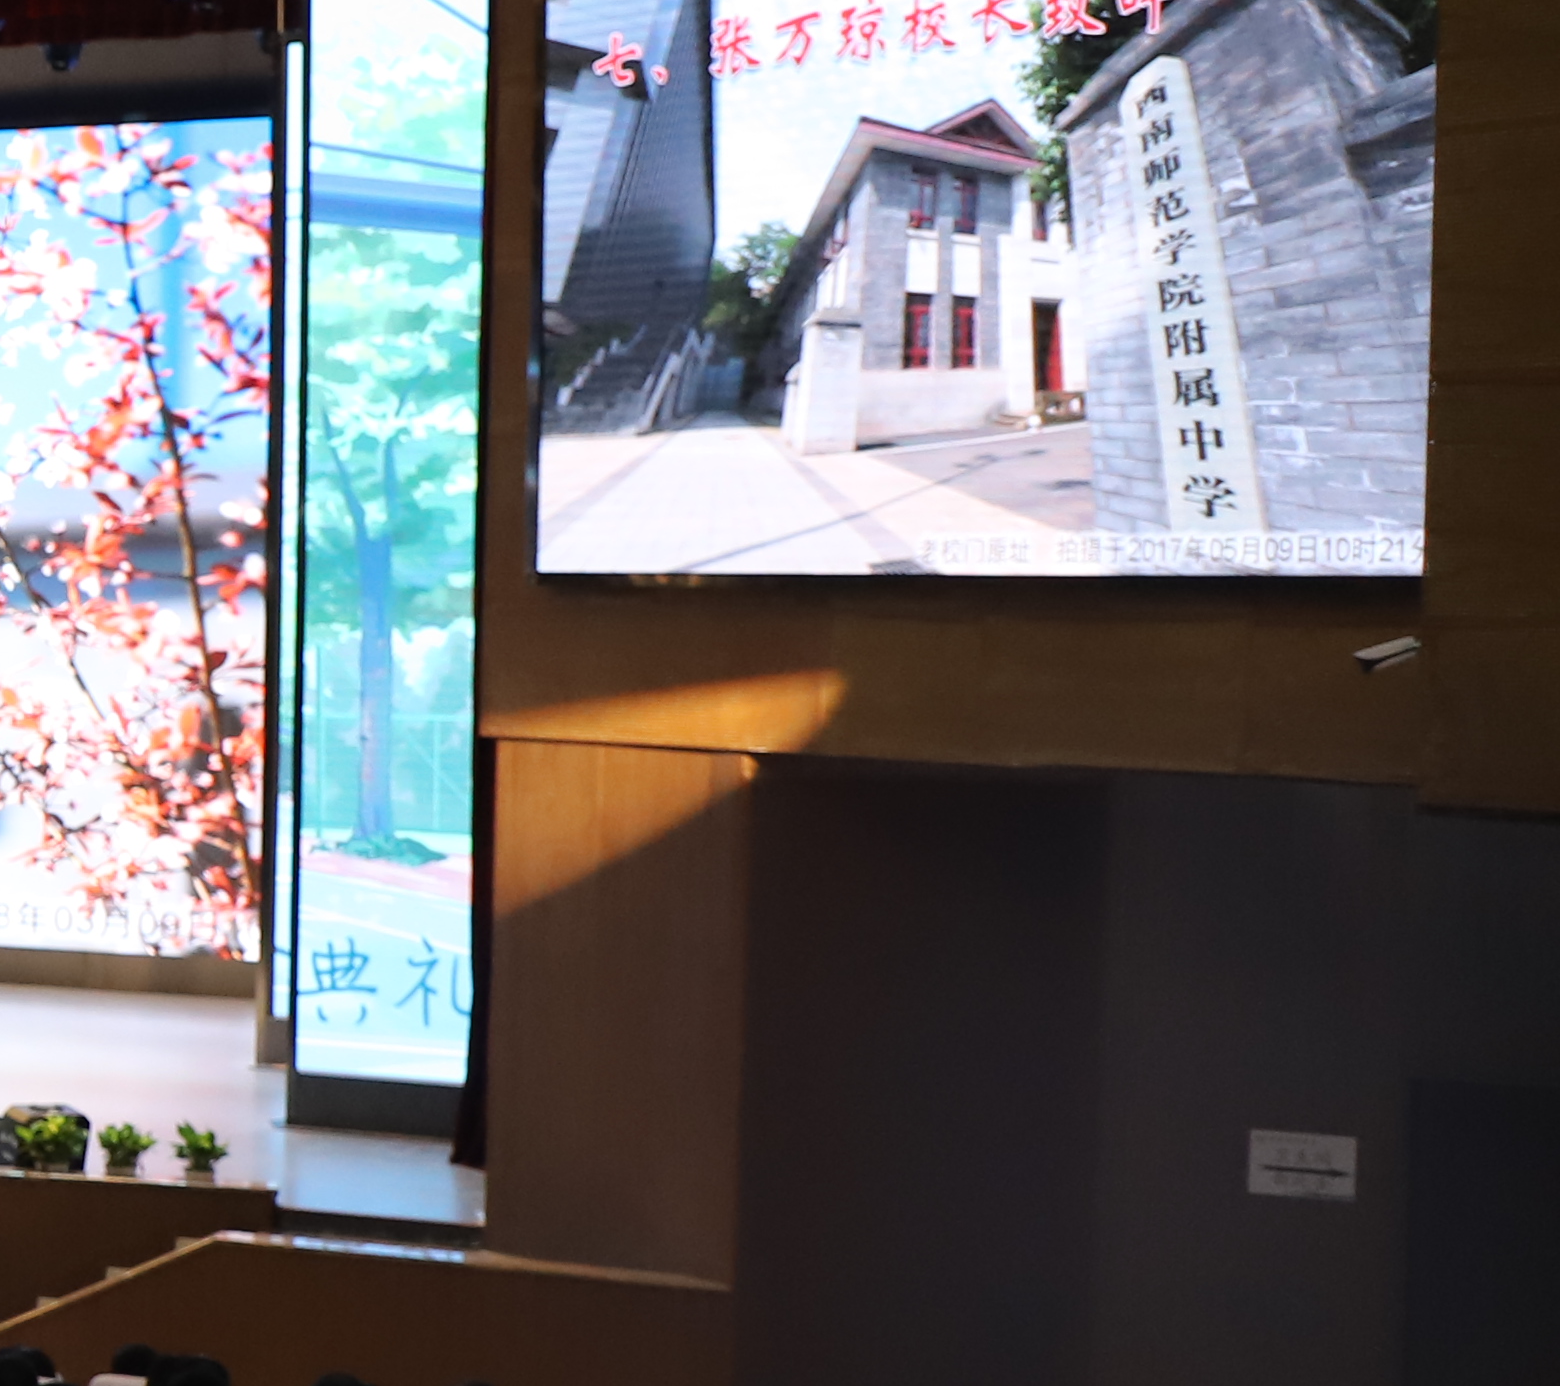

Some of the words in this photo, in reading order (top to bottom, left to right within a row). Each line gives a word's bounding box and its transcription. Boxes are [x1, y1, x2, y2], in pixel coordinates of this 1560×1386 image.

[1134, 73, 1240, 521] 西南师范学院附属中学
